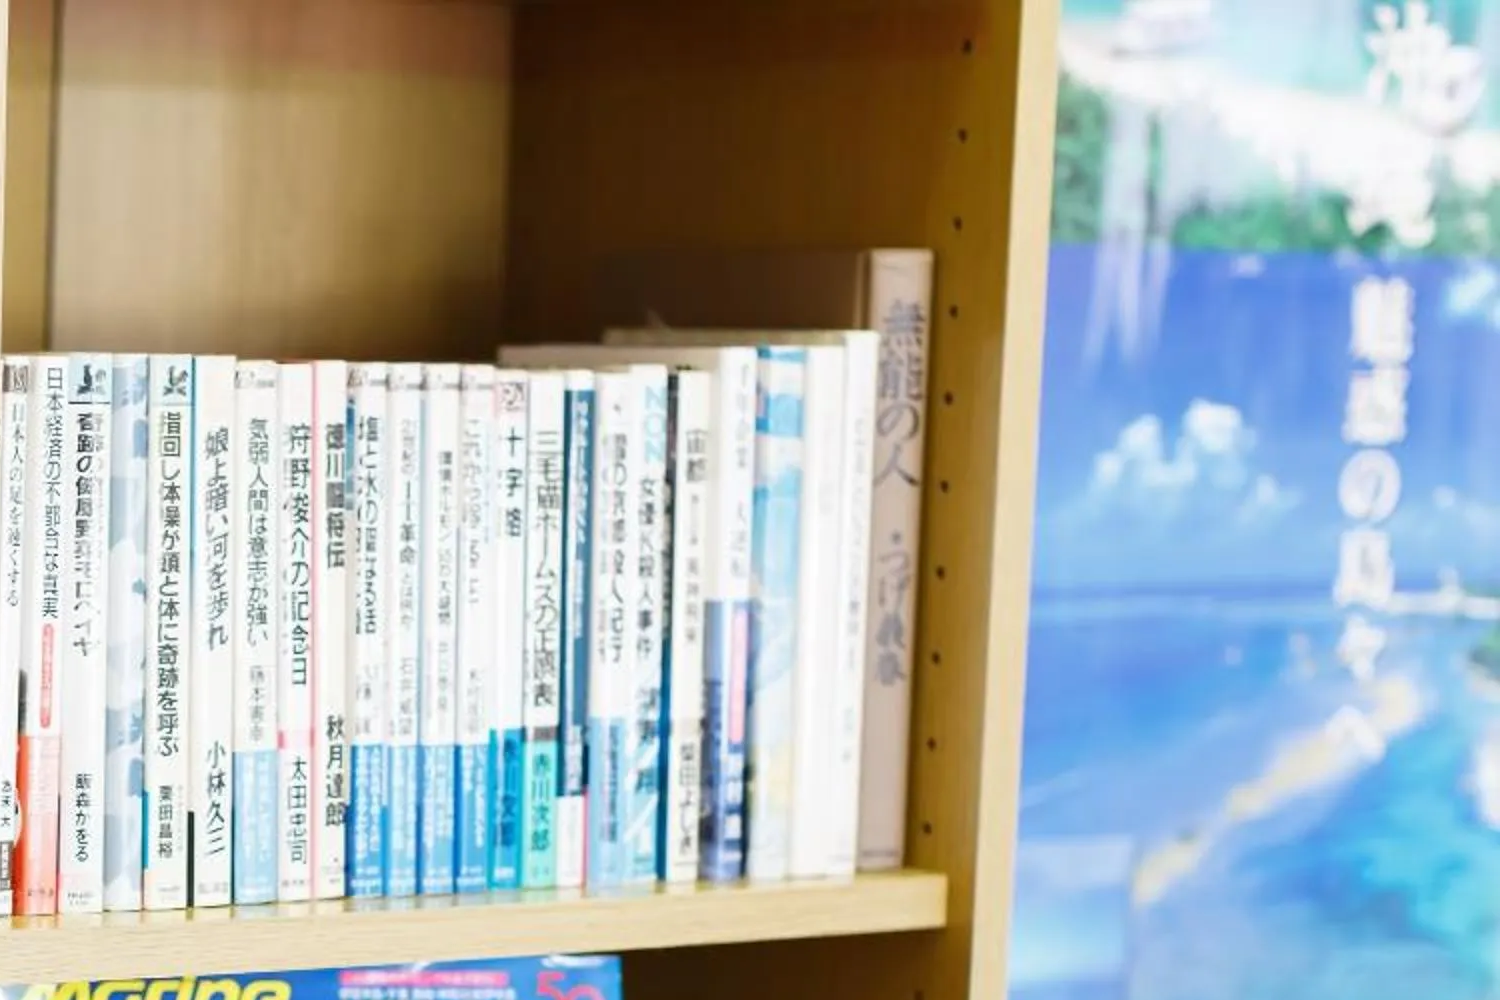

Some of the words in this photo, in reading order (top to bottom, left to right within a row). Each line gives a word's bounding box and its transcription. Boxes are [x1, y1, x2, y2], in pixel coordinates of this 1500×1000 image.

[206, 740, 227, 856] 小林久三
[287, 756, 308, 864] 太田忠司
